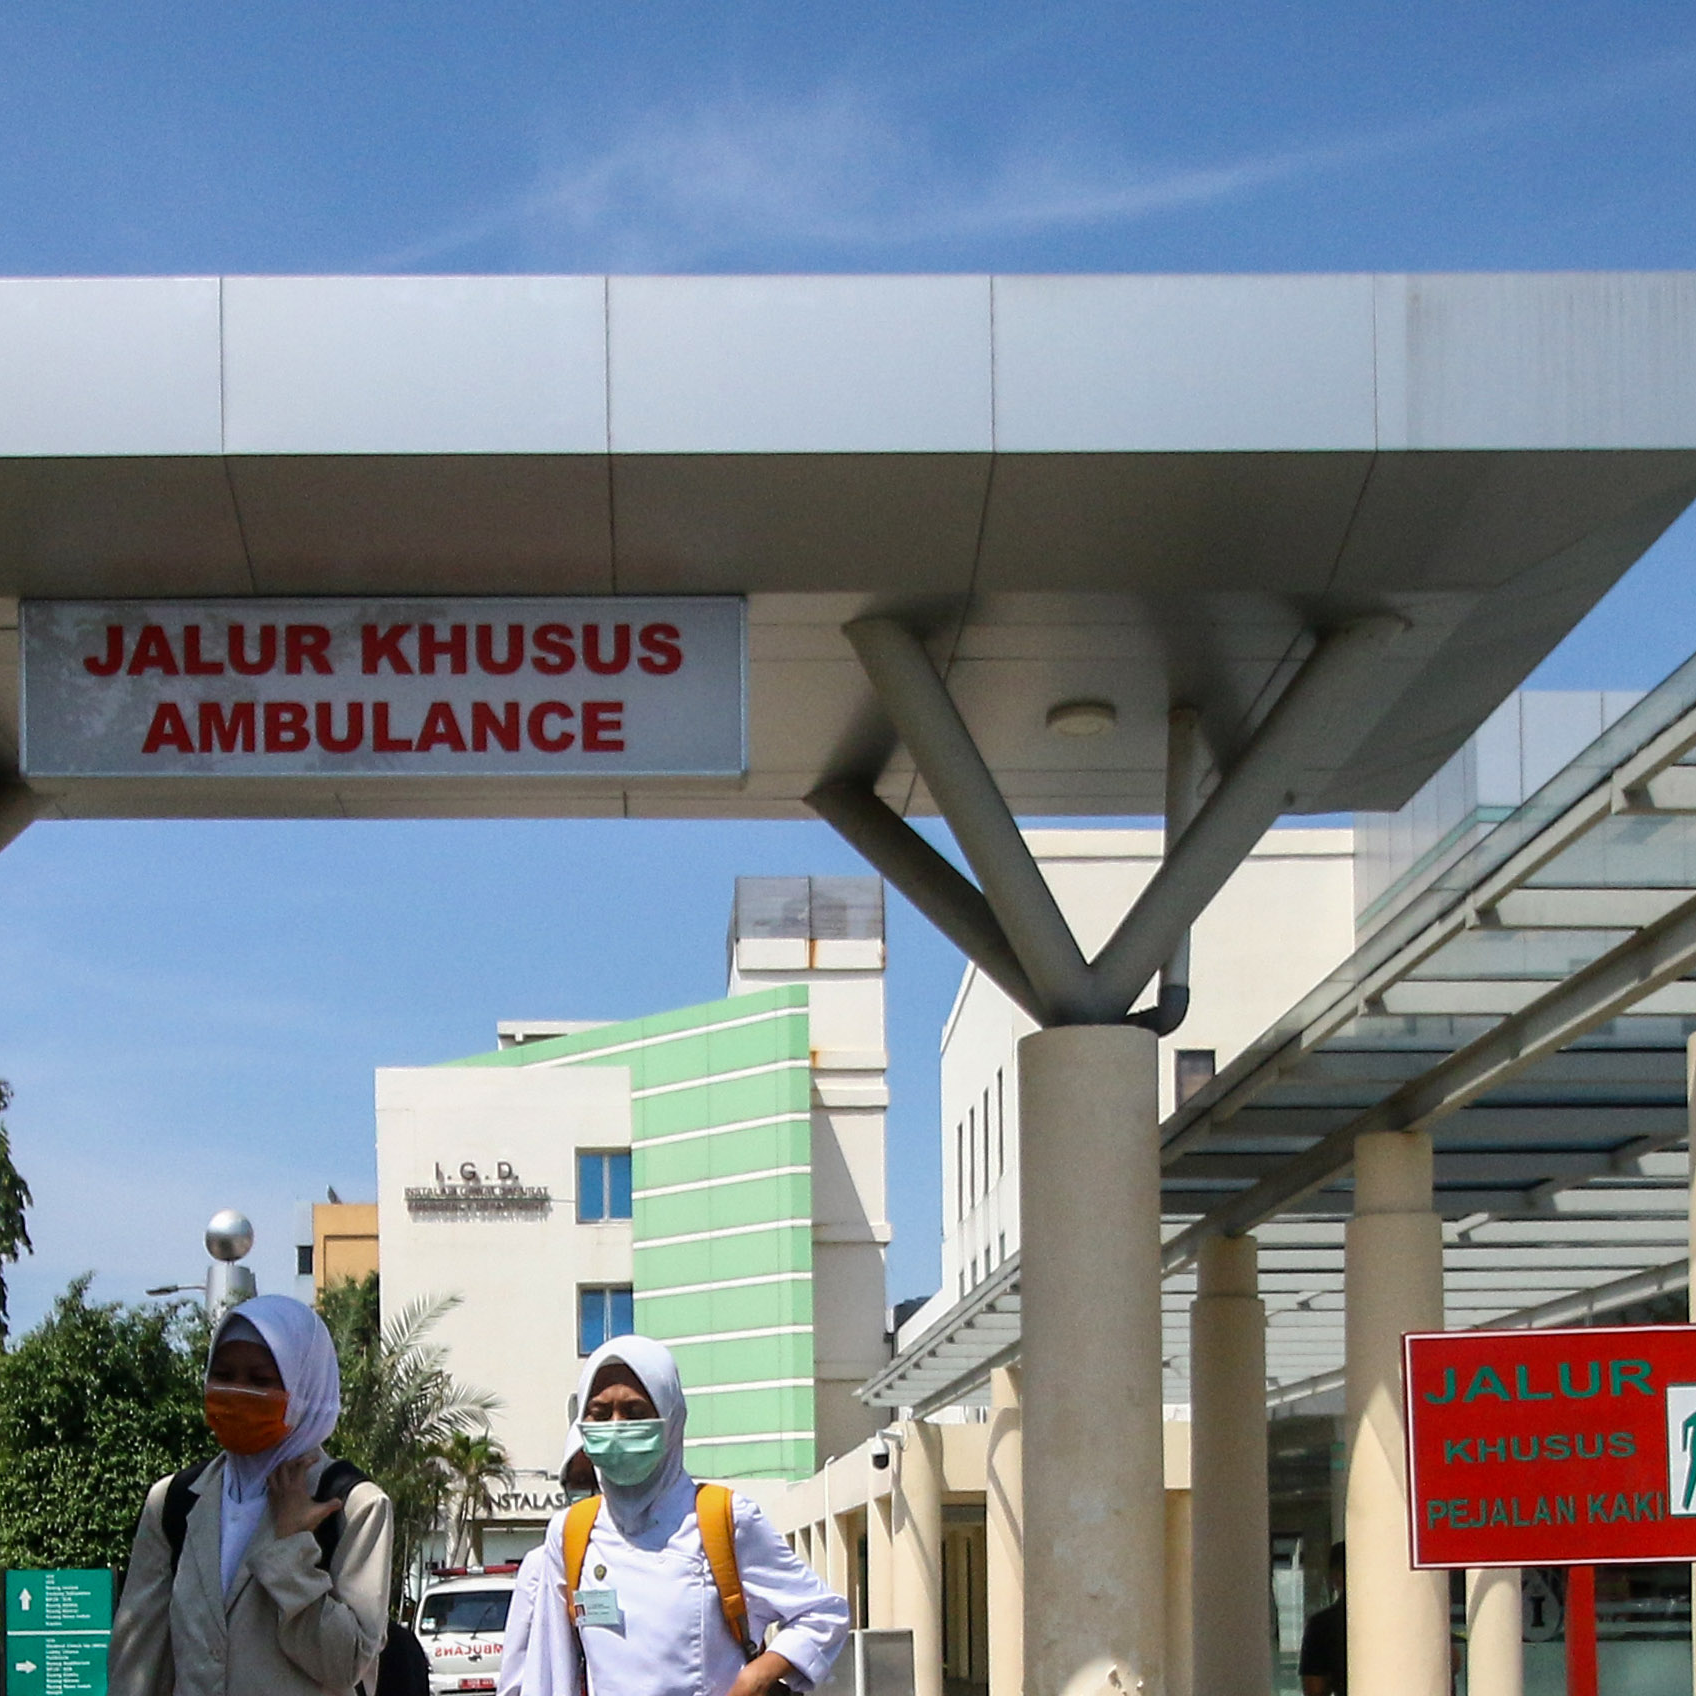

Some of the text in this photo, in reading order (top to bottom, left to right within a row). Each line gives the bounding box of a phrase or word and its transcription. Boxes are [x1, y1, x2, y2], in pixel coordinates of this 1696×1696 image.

[84, 624, 683, 676] JALUR KHUSUS
[142, 701, 625, 754] AMBULANCE
[1425, 1360, 1655, 1404] JALUR
[1444, 1432, 1637, 1464] KHUSUS
[491, 1493, 566, 1511] NSTALAS
[1427, 1491, 1665, 1529] PEJALAN KAKI
